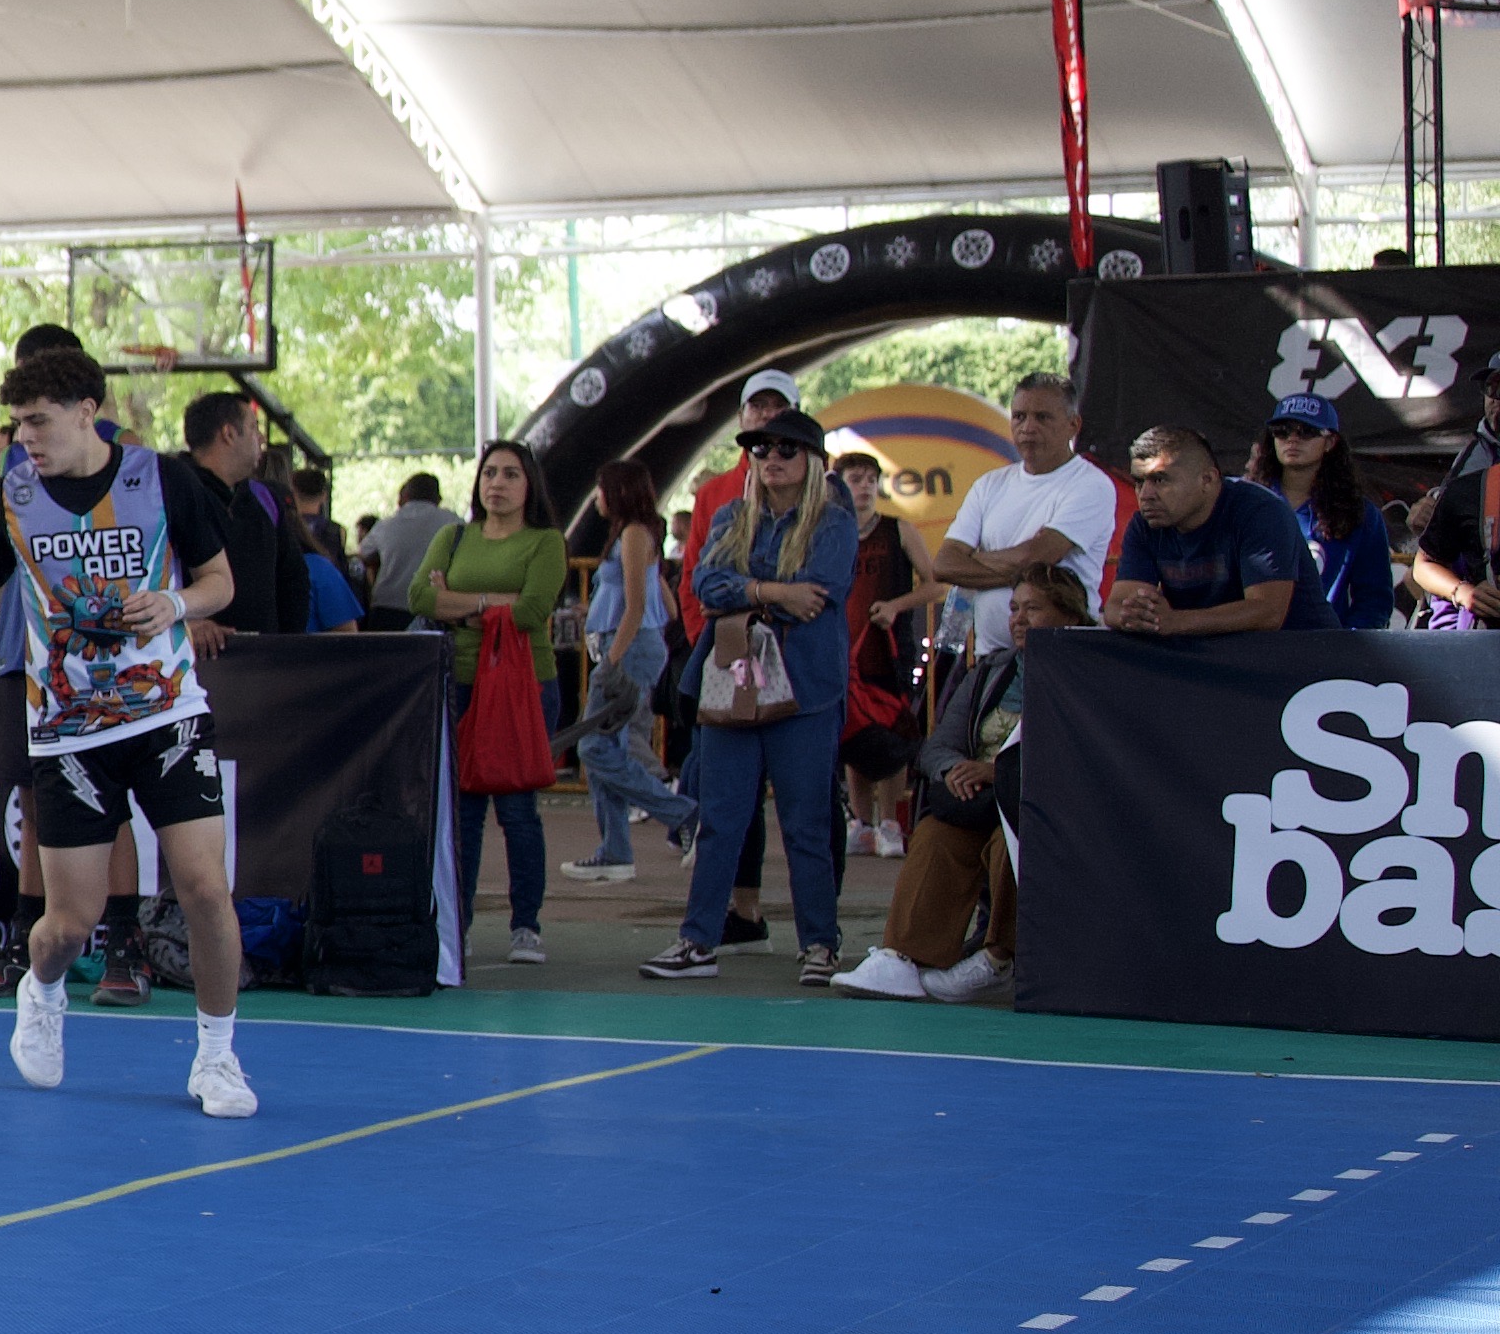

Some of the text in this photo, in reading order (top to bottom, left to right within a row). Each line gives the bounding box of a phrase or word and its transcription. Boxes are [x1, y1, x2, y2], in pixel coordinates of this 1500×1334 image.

[31, 526, 142, 563] POWER
[83, 553, 145, 579] ADE
[1271, 679, 1500, 840] Sn
[1215, 792, 1500, 959] ba
